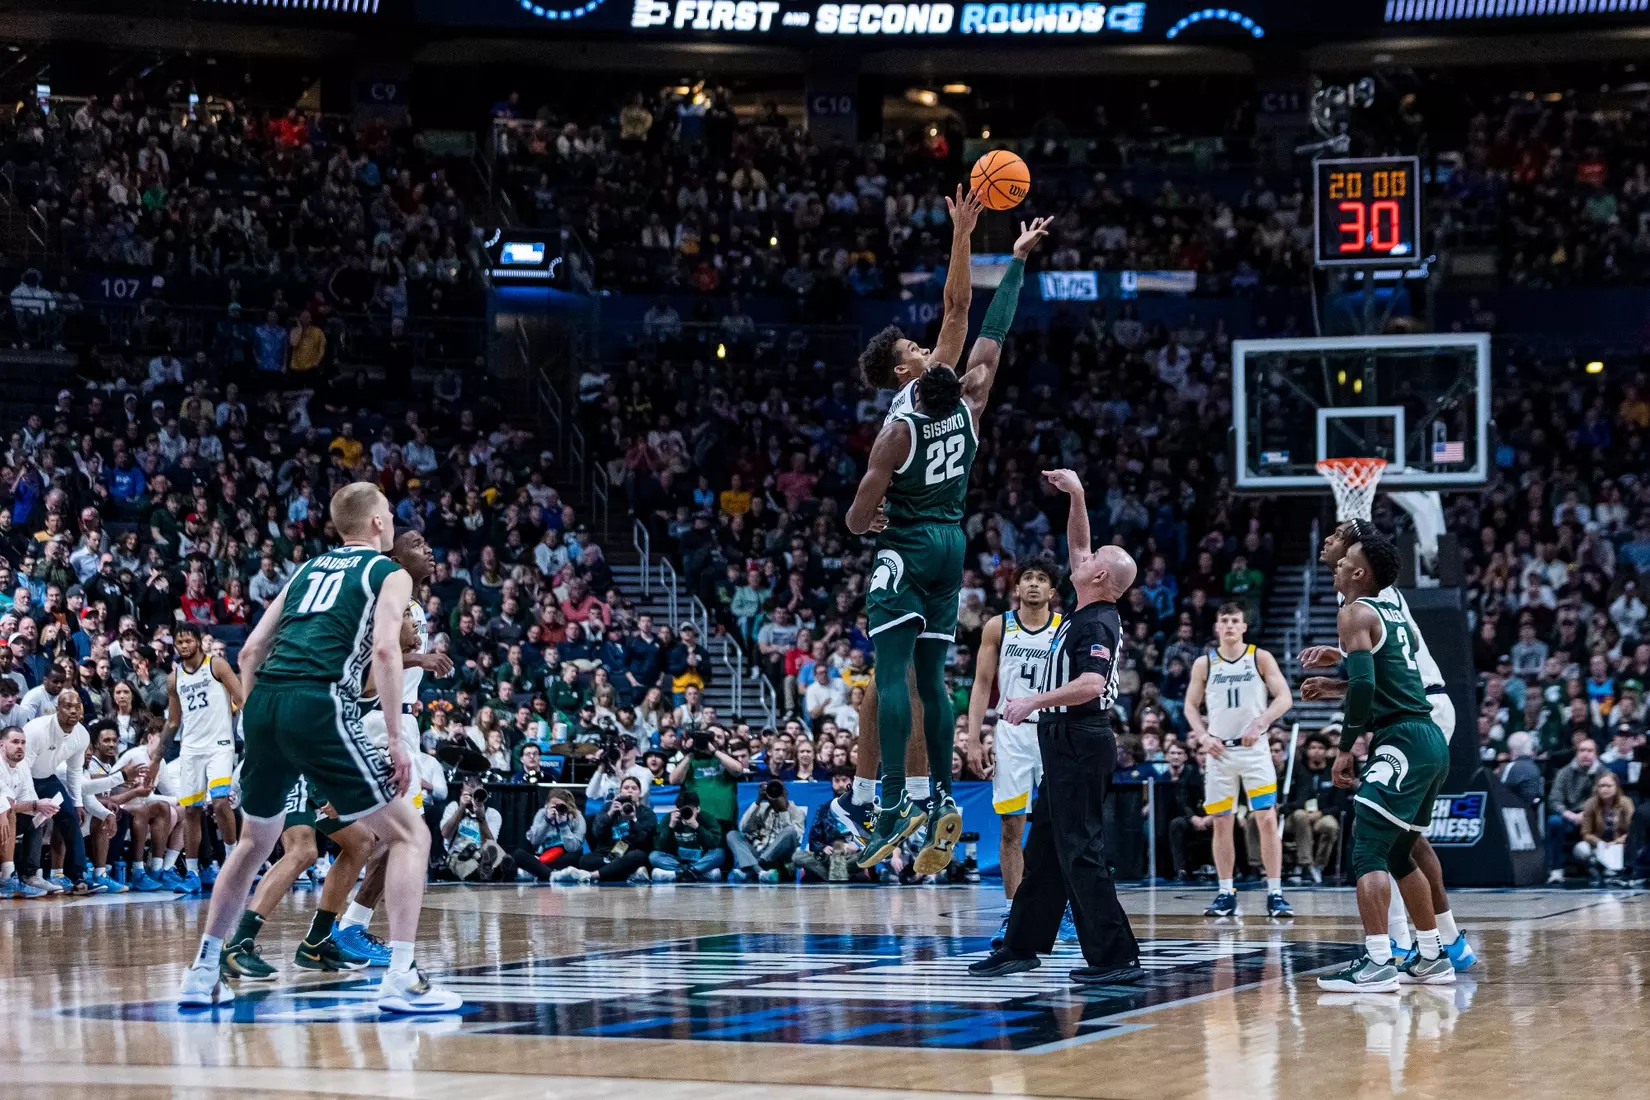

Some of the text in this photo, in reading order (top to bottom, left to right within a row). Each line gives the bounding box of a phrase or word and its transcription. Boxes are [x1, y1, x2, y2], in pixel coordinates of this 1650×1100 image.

[674, 0, 780, 31] FIRST
[815, 4, 954, 34] SECOND
[960, 3, 1106, 34] ROUNDS
[371, 83, 397, 101] C9
[812, 95, 852, 114] C10
[1329, 171, 1407, 199] 20 00
[1338, 201, 1400, 252] 30
[101, 277, 140, 299] 107
[922, 412, 965, 439] SISSOKO
[925, 434, 965, 485] 22
[311, 555, 363, 570] HAUSER
[297, 570, 346, 613] 10
[1396, 626, 1418, 670] 2
[1021, 663, 1037, 689] 4
[187, 692, 209, 711] 23
[1227, 687, 1240, 708] 11
